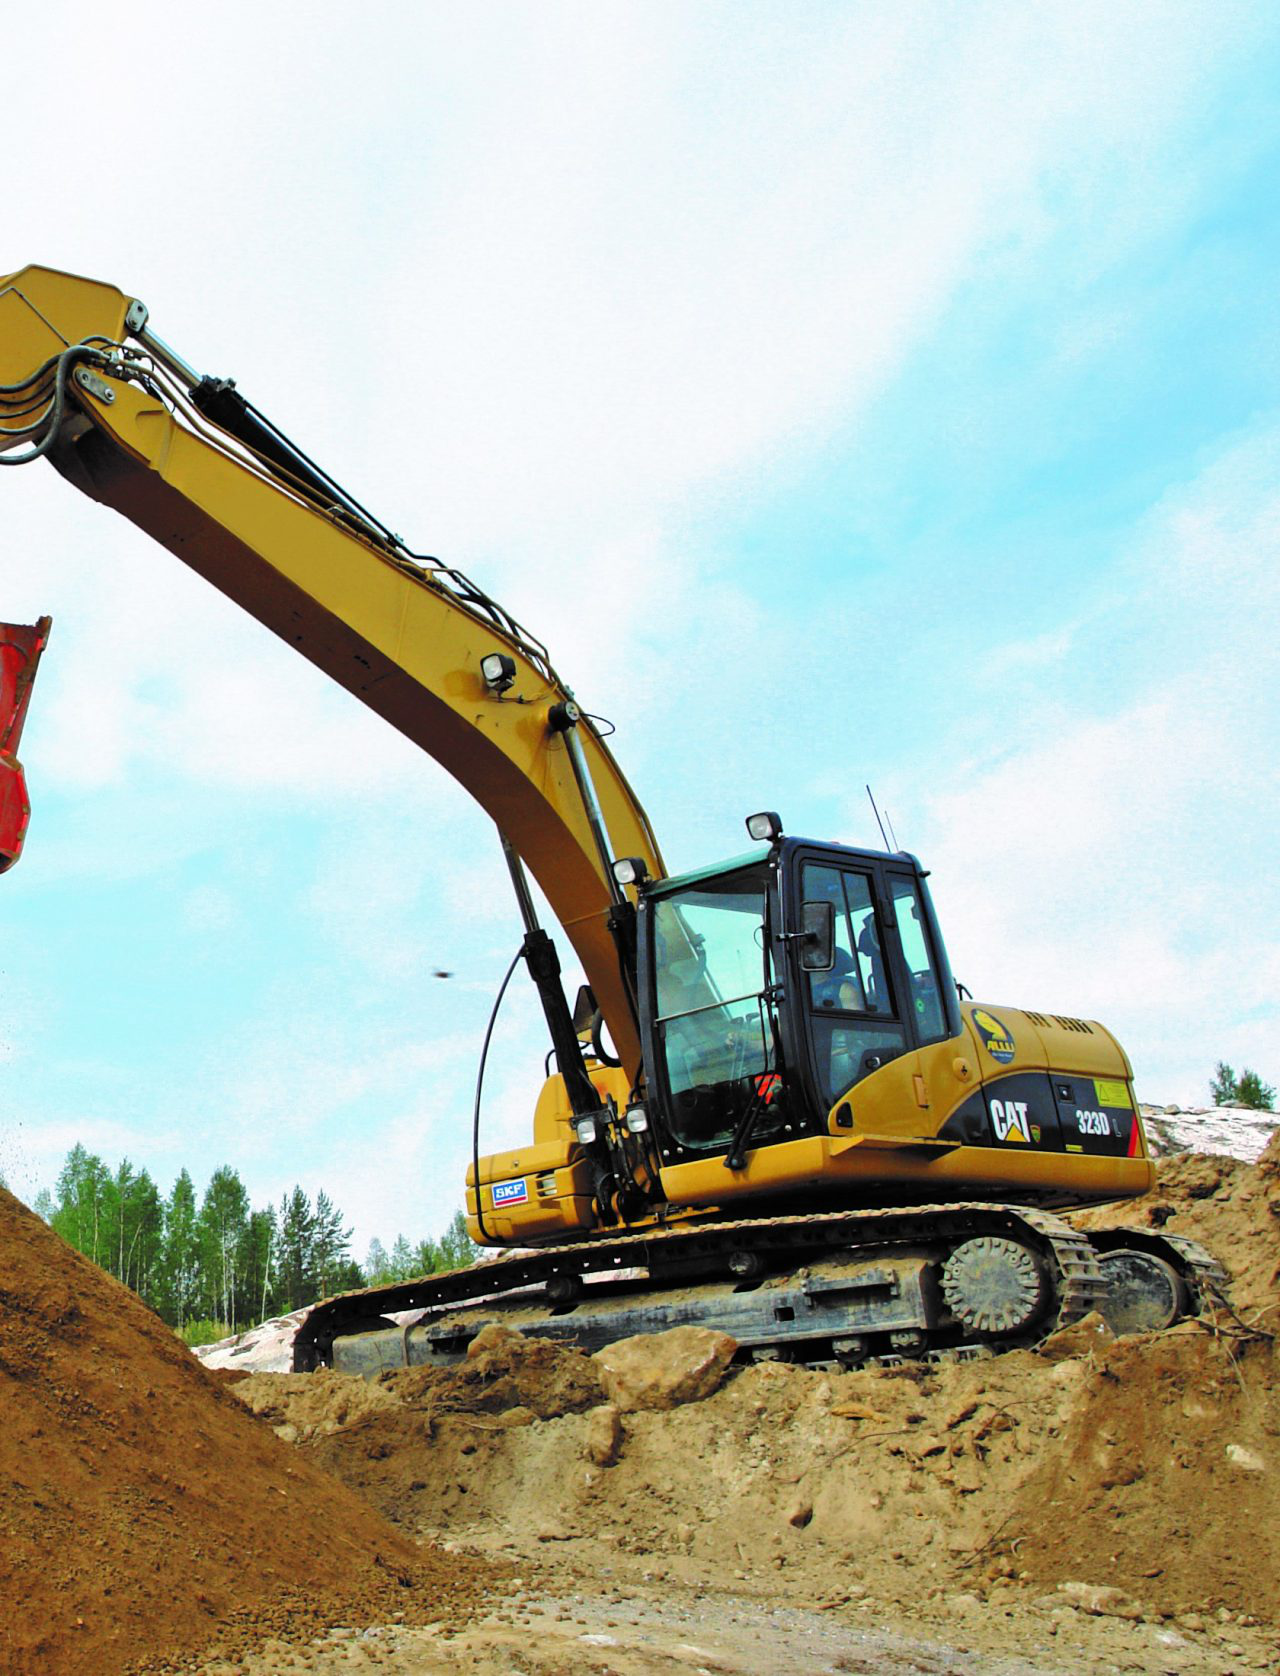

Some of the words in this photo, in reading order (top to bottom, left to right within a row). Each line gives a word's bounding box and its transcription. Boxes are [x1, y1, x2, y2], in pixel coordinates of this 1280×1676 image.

[987, 1040, 1015, 1053] ALLU
[990, 1099, 1031, 1143] CAT
[1075, 1109, 1111, 1136] 323D
[495, 1183, 523, 1199] SKF
